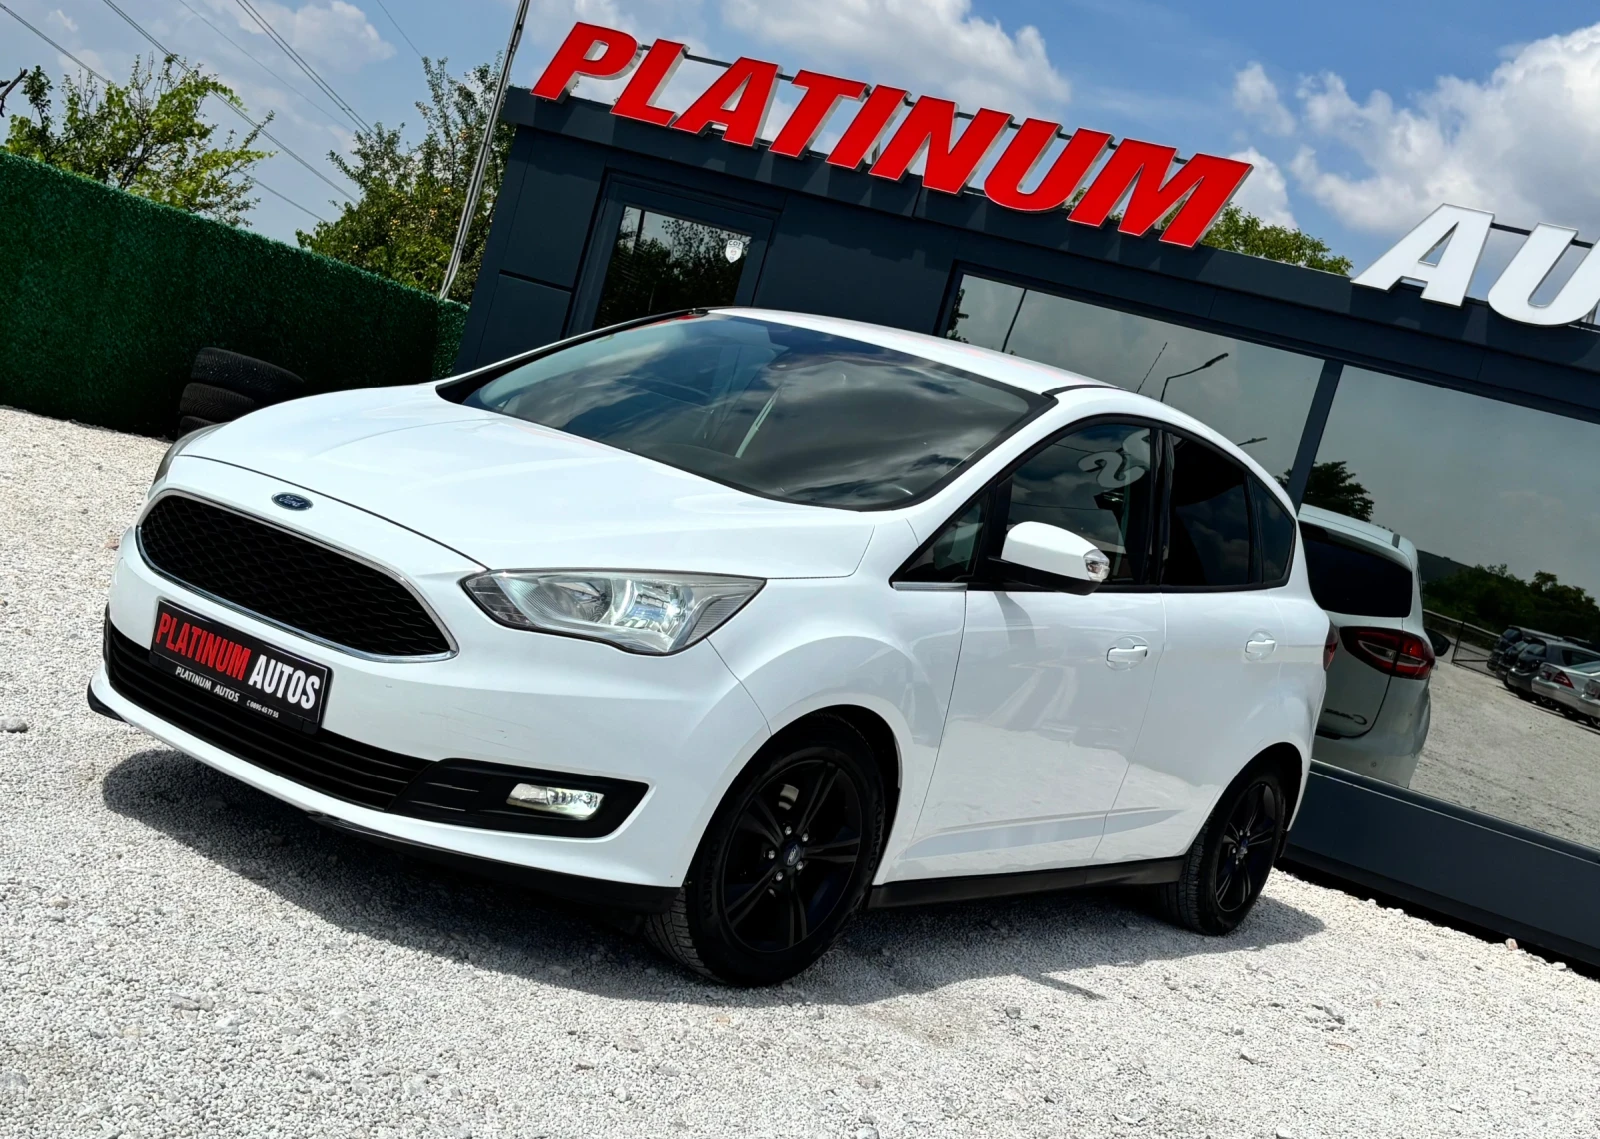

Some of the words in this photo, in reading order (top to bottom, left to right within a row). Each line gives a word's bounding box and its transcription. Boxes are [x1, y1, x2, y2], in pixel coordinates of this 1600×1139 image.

[531, 22, 1253, 248] PLATINUM
[1351, 203, 1600, 326] AU
[155, 612, 251, 681] PLATINUM
[248, 654, 320, 709] AUTOS
[175, 666, 212, 691] PLATINUM
[213, 684, 240, 702] AUTOS
